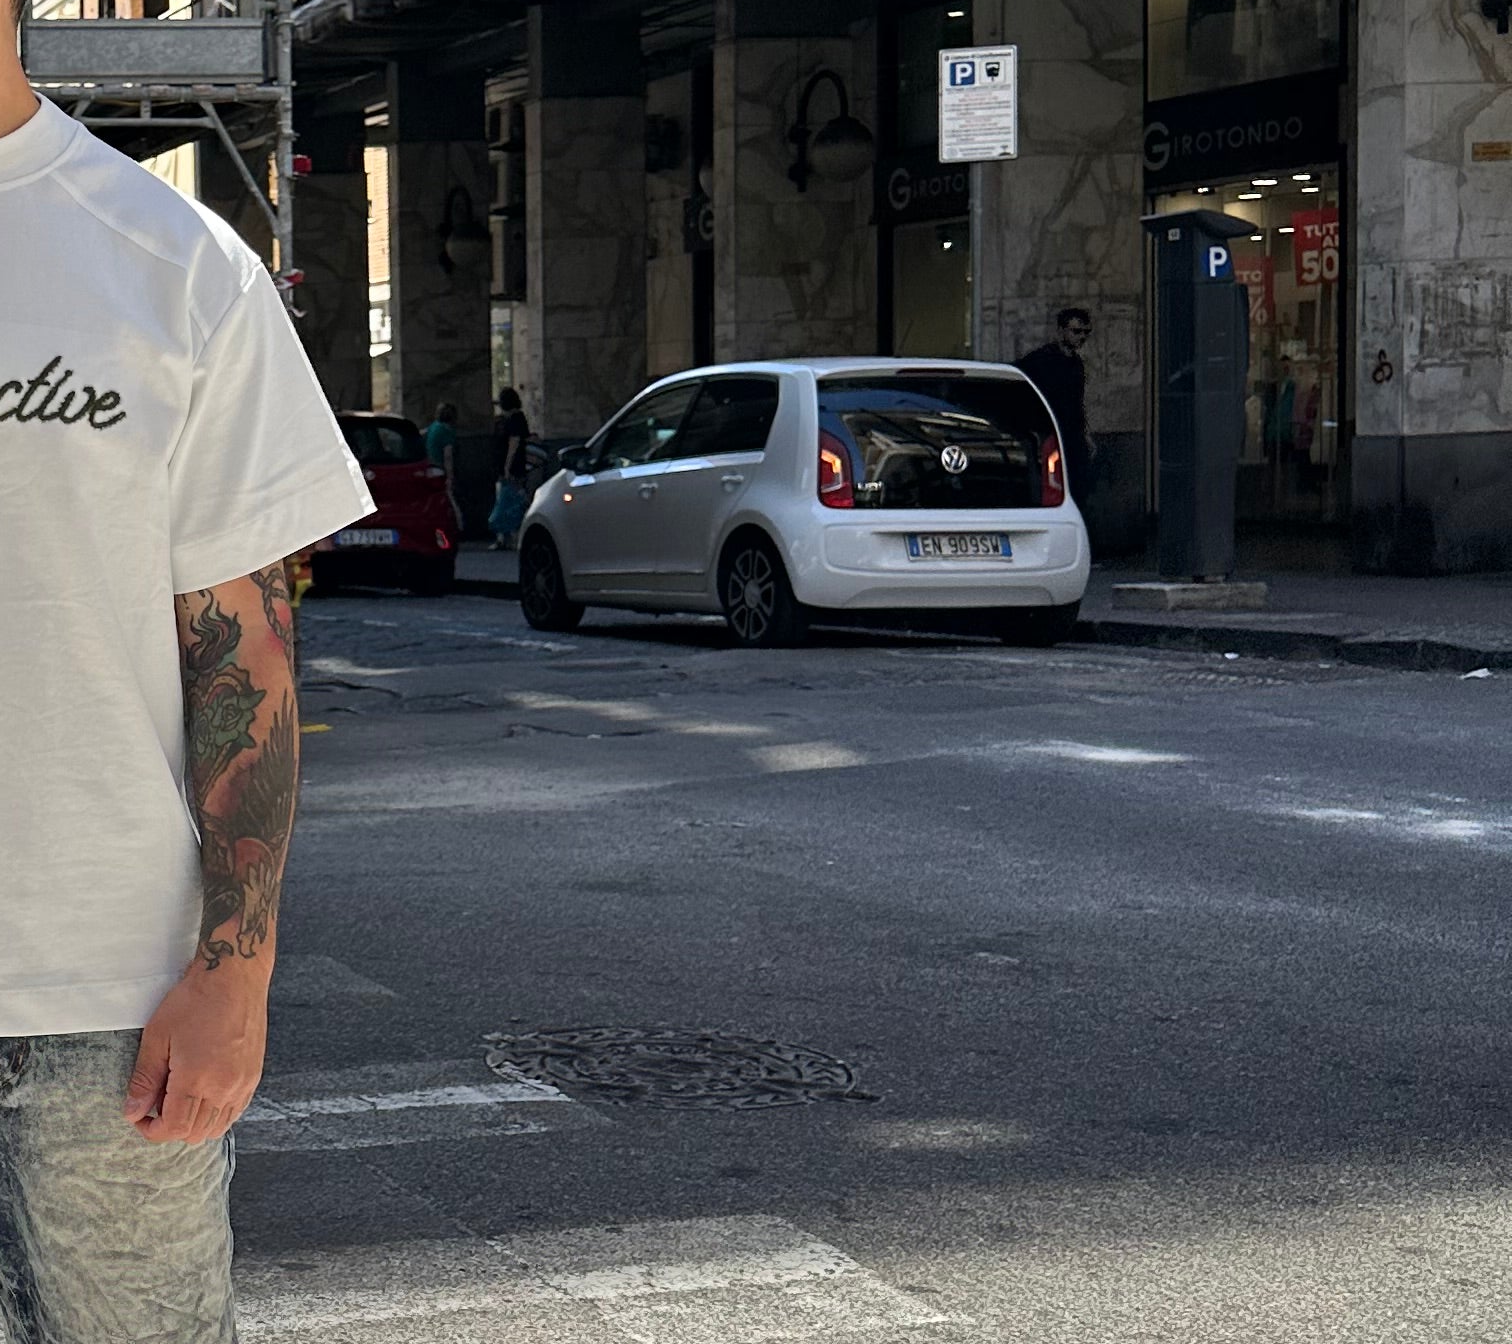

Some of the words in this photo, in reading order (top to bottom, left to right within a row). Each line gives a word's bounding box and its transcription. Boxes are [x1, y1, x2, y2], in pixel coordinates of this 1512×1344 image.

[1208, 246, 1228, 277] P
[921, 534, 942, 554] EN
[948, 535, 1001, 554] 909SW
